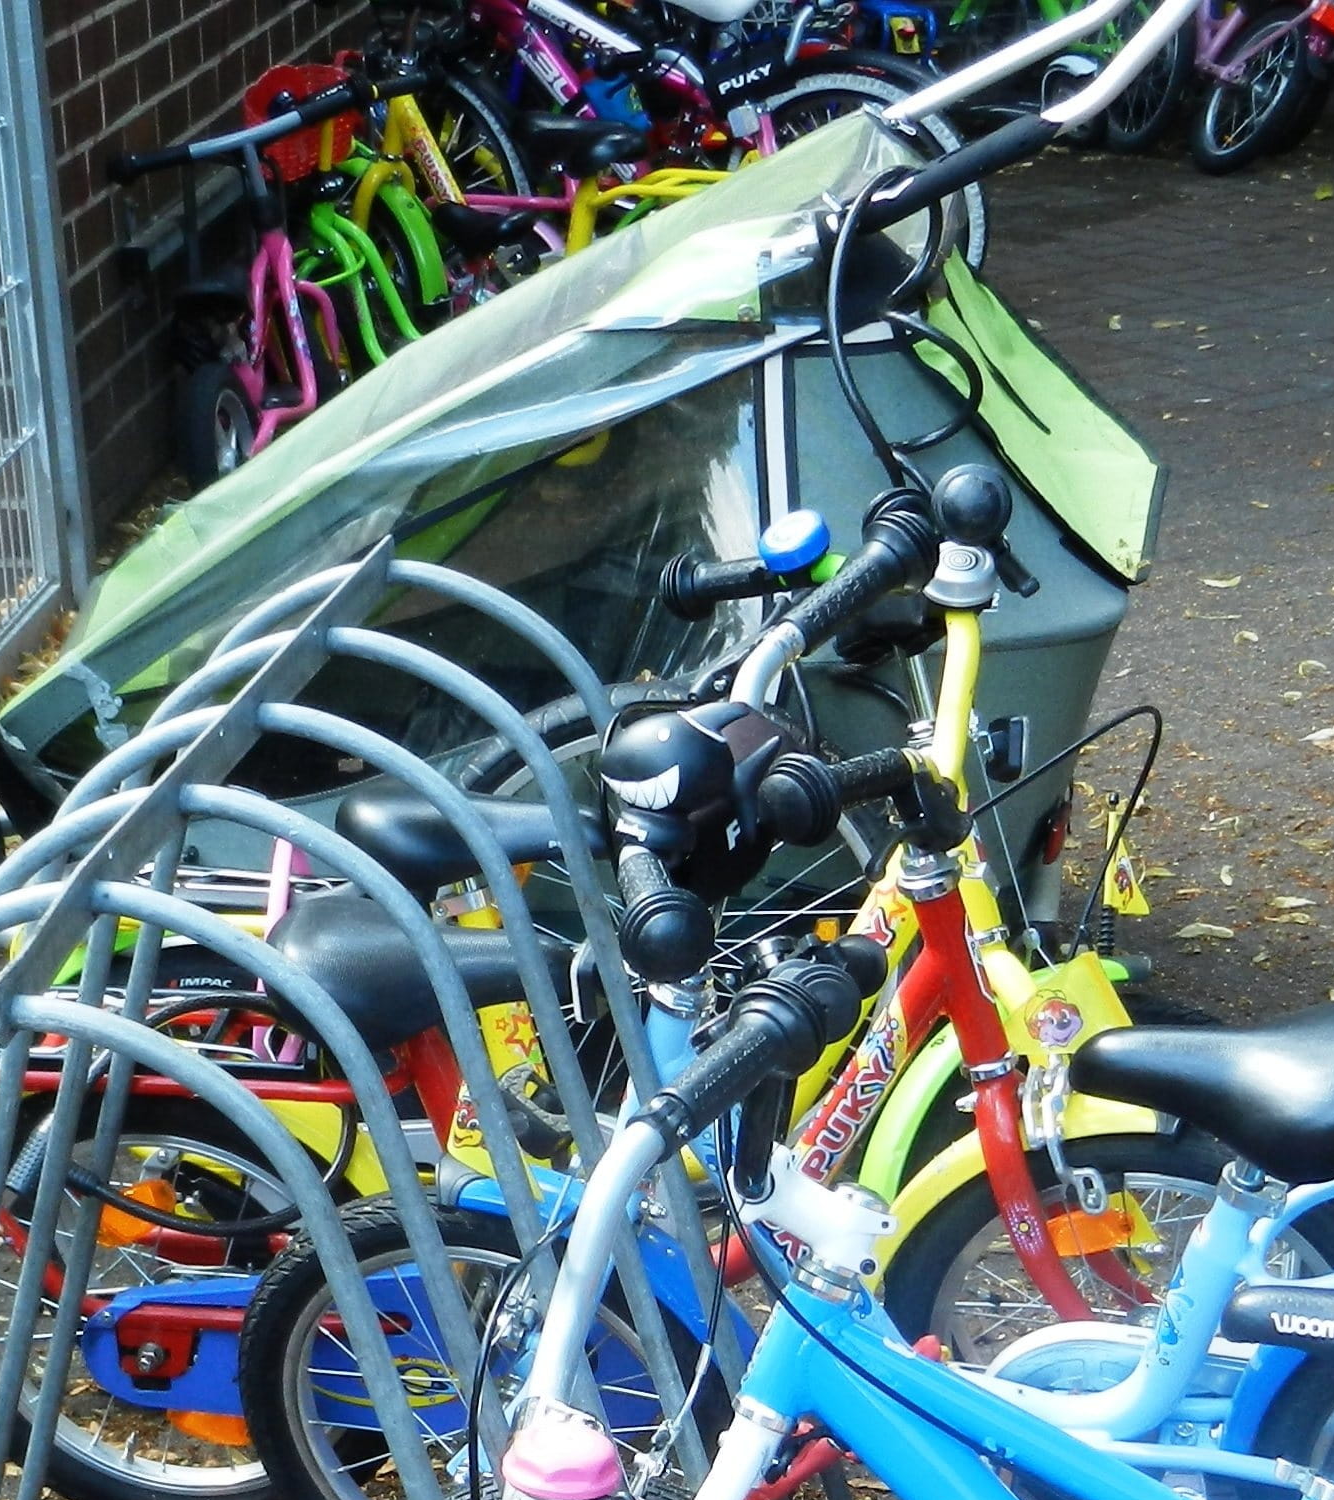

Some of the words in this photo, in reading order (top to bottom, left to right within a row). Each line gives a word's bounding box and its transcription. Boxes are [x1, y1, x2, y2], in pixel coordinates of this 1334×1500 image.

[718, 63, 772, 96] PUKY
[179, 977, 233, 988] IMPAC
[798, 1045, 895, 1183] PUKY
